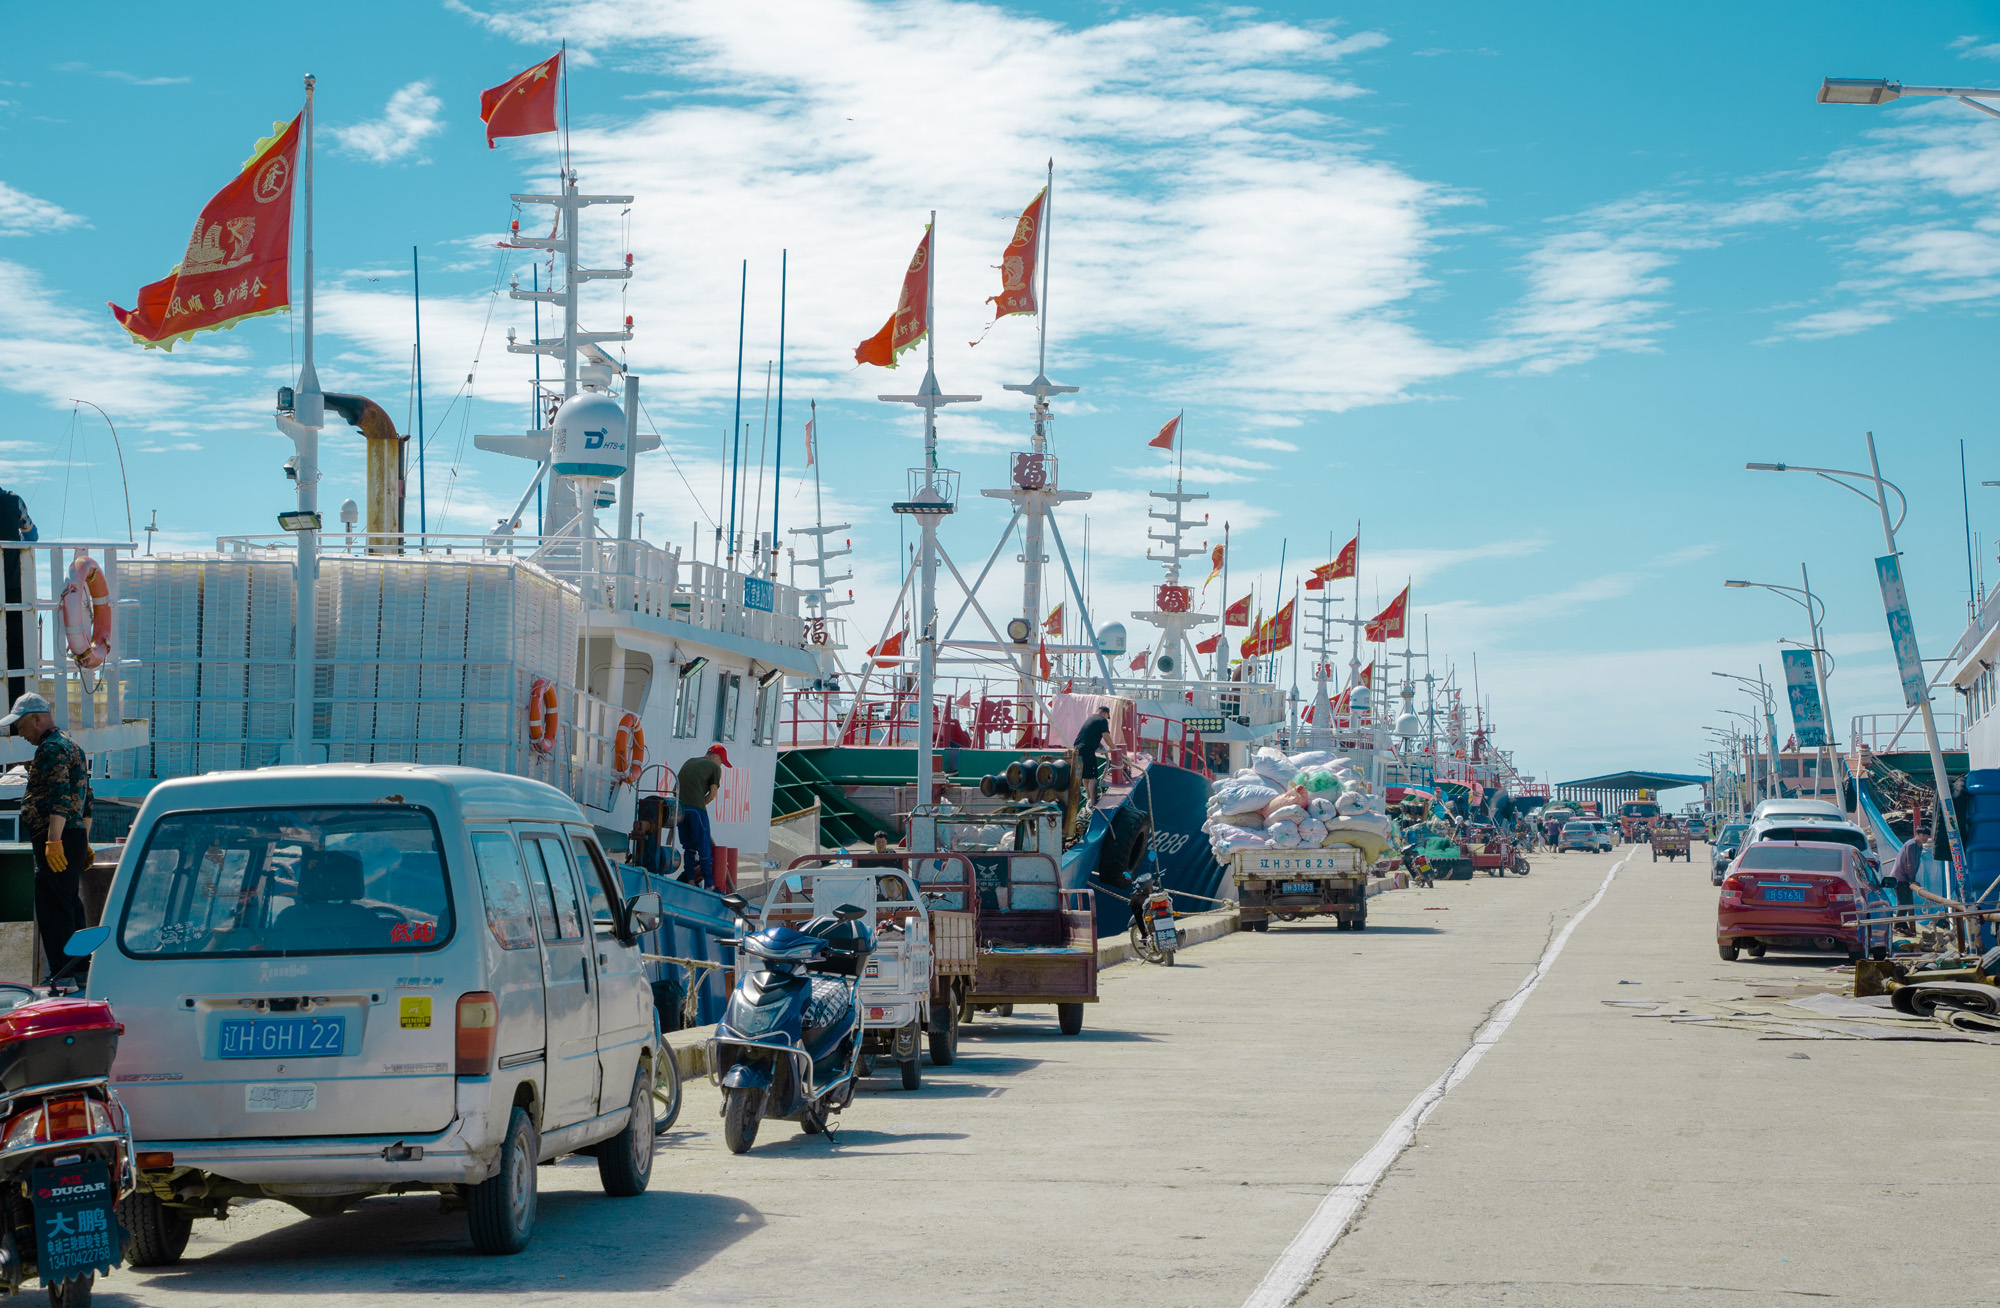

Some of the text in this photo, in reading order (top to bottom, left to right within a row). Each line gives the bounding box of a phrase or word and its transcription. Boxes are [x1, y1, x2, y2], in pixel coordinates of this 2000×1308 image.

[165, 293, 206, 320] 风顺
[715, 767, 751, 824] CHINA
[401, 1016, 431, 1024] WINNIE
[51, 1182, 107, 1197] DUCAR
[46, 1208, 108, 1239] 大鹏
[47, 1231, 110, 1256] 电动三轮四轮专卖
[48, 1246, 111, 1270] 13470422758
